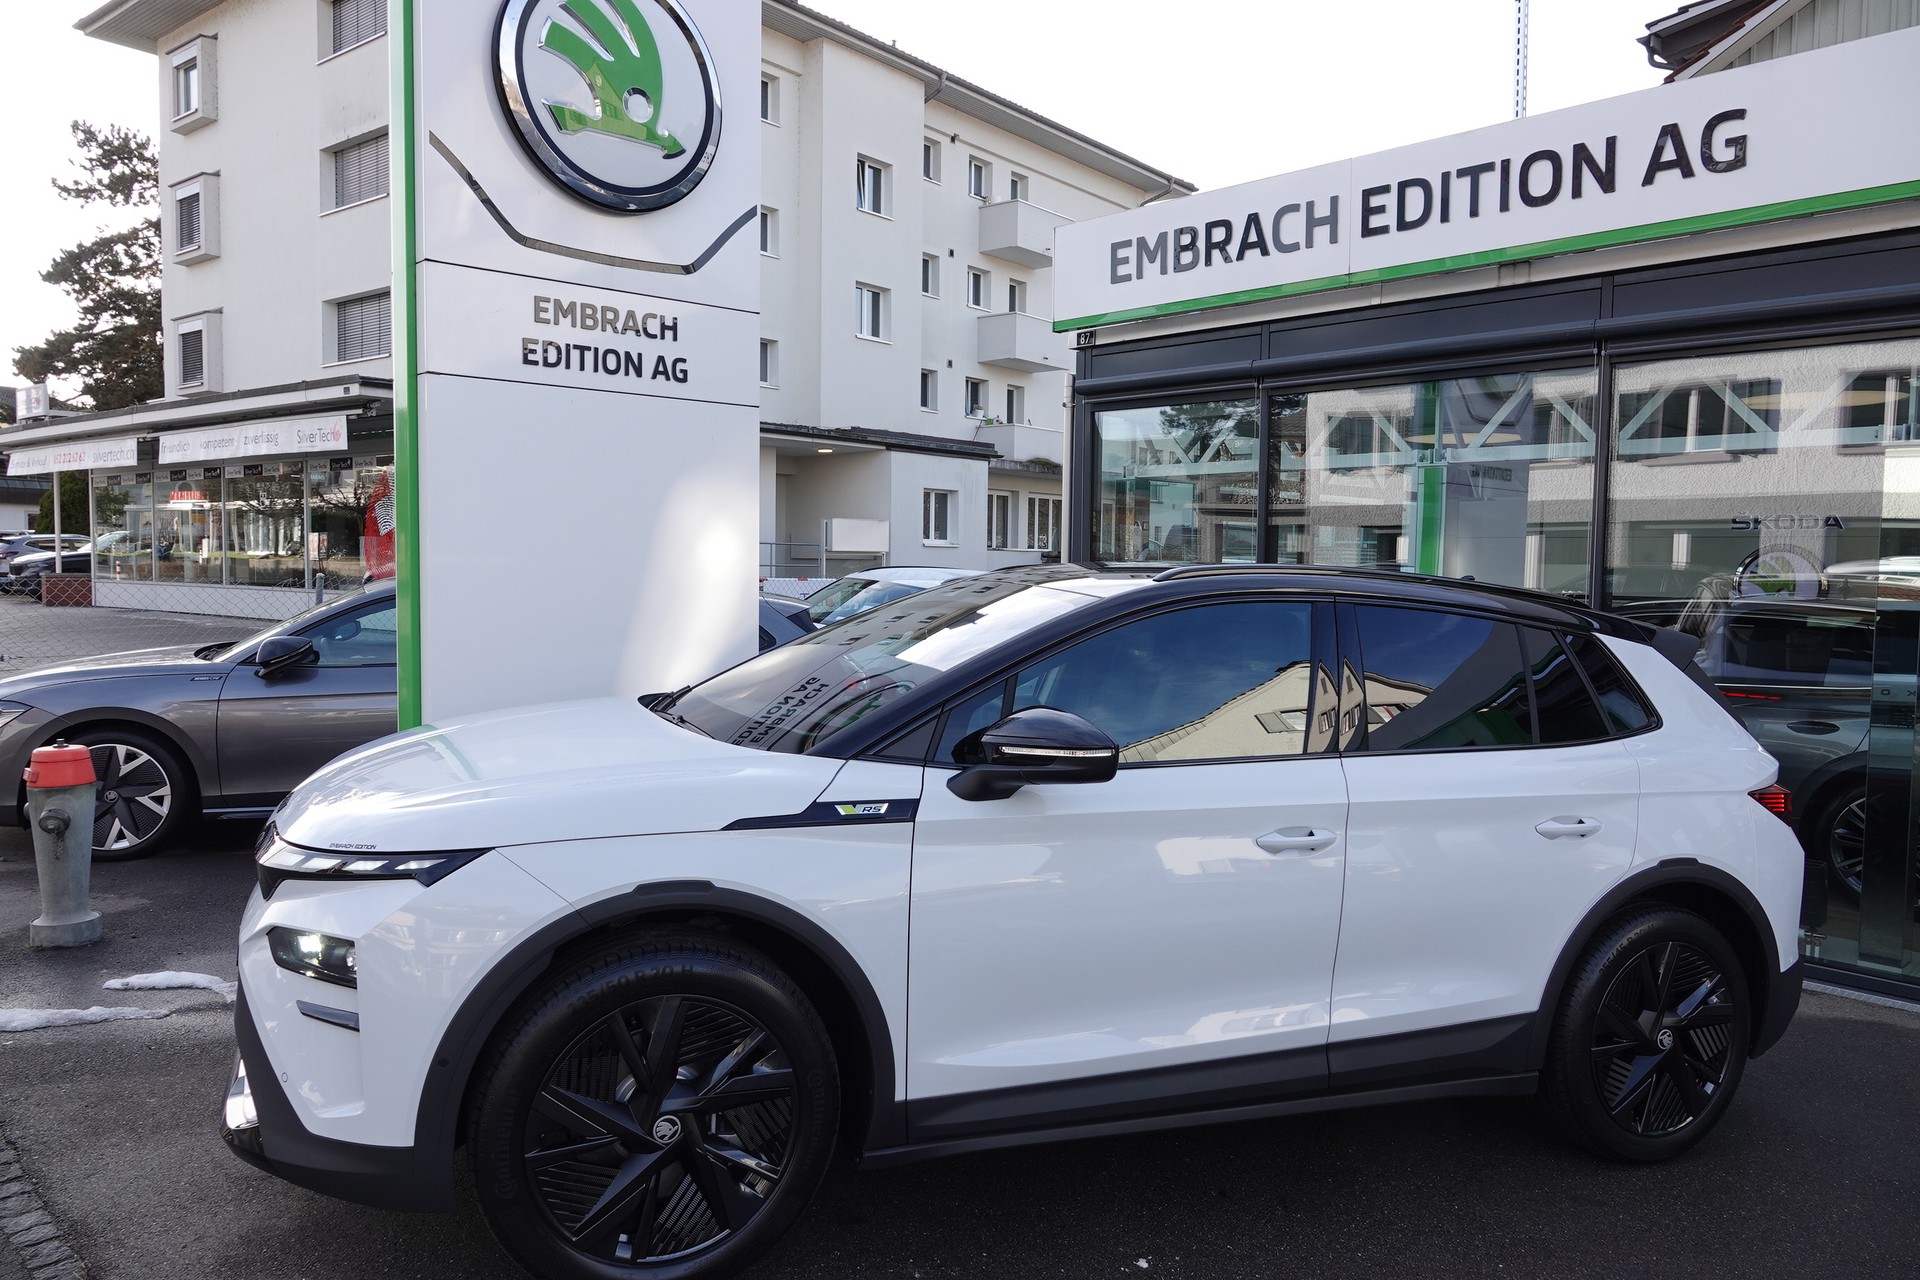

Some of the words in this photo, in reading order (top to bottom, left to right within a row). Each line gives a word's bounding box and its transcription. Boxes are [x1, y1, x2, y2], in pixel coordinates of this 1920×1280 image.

[1110, 195, 1339, 285] EMBRACH
[1361, 135, 1617, 239] EDITION
[1641, 108, 1748, 188] AG
[533, 295, 678, 342] EMBRACH
[1080, 333, 1090, 344] 87
[522, 337, 643, 378] EDITION
[650, 355, 688, 384] AG
